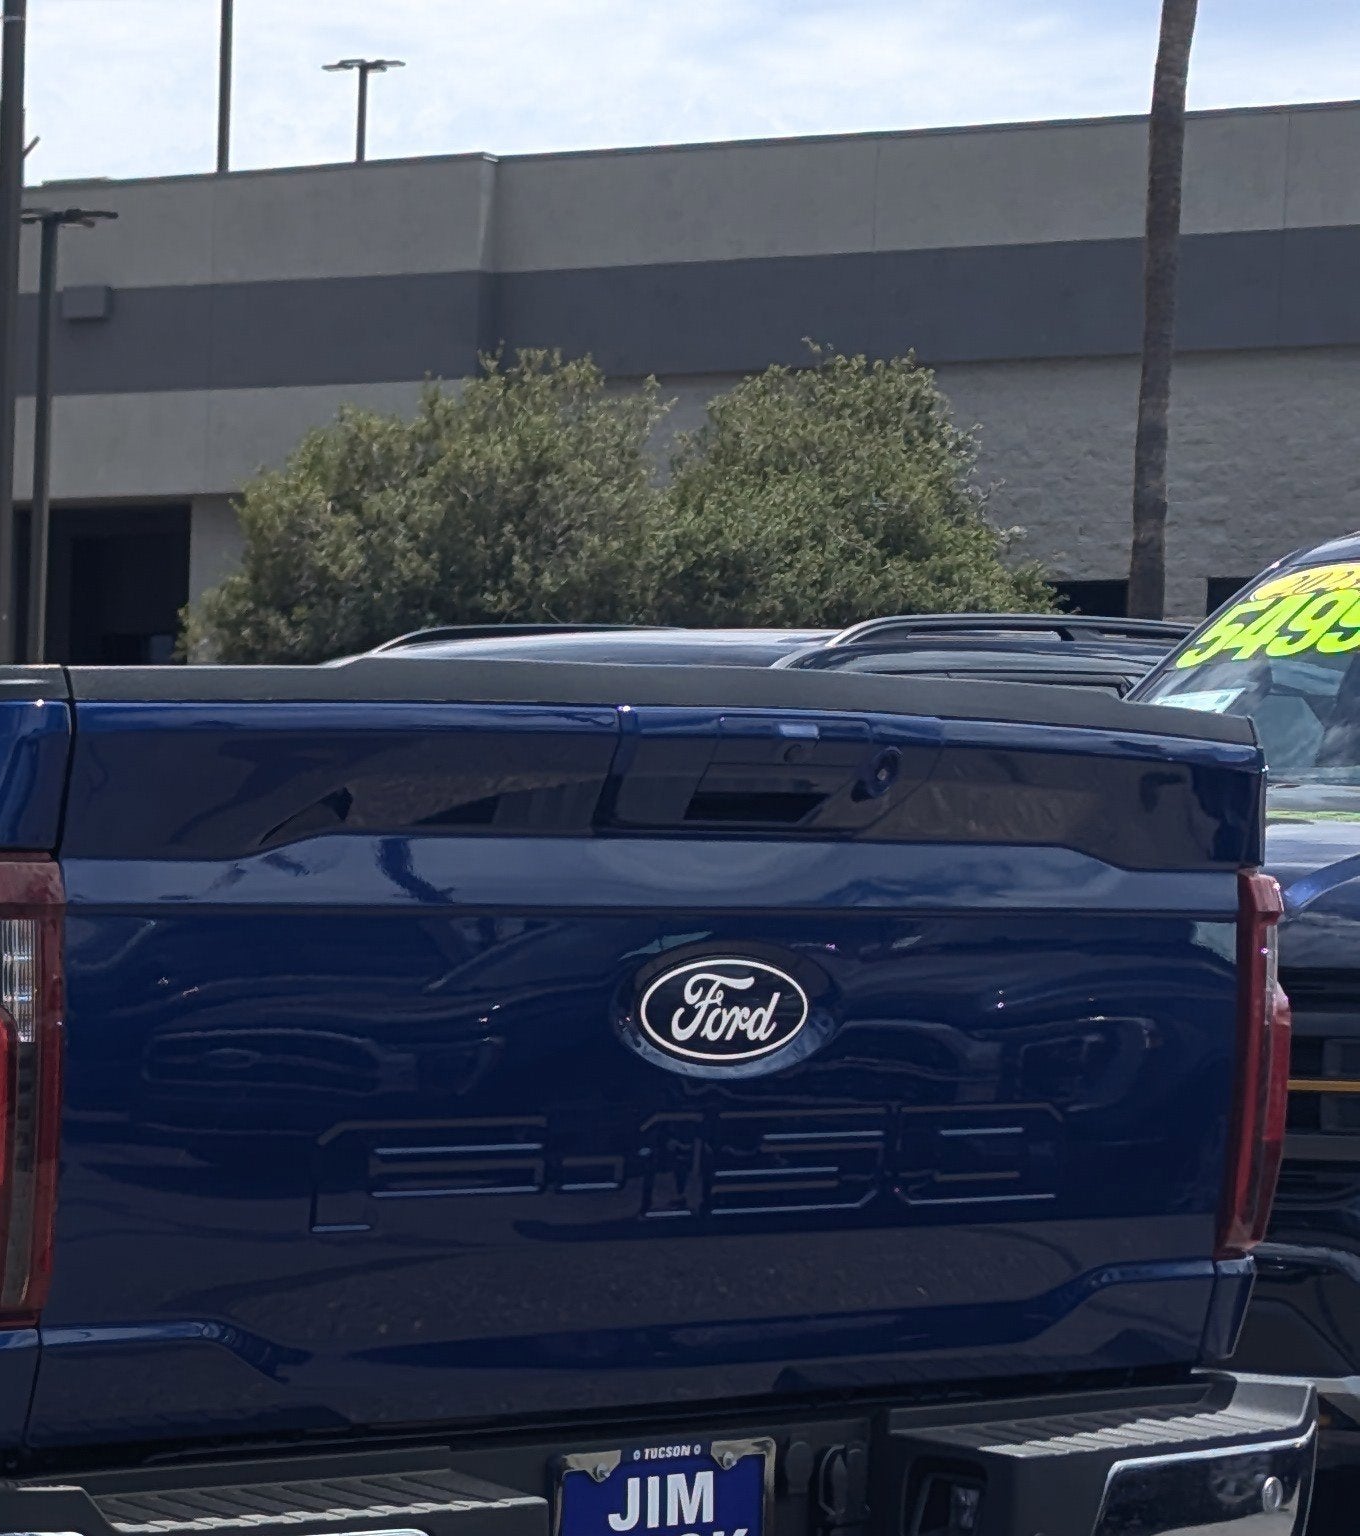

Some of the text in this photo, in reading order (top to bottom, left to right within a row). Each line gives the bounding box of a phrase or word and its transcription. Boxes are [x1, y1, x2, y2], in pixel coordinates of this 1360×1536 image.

[671, 973, 781, 1041] Ford
[311, 1103, 1064, 1232] F-150
[644, 1445, 691, 1460] TUCSON
[608, 1471, 714, 1531] JIM
